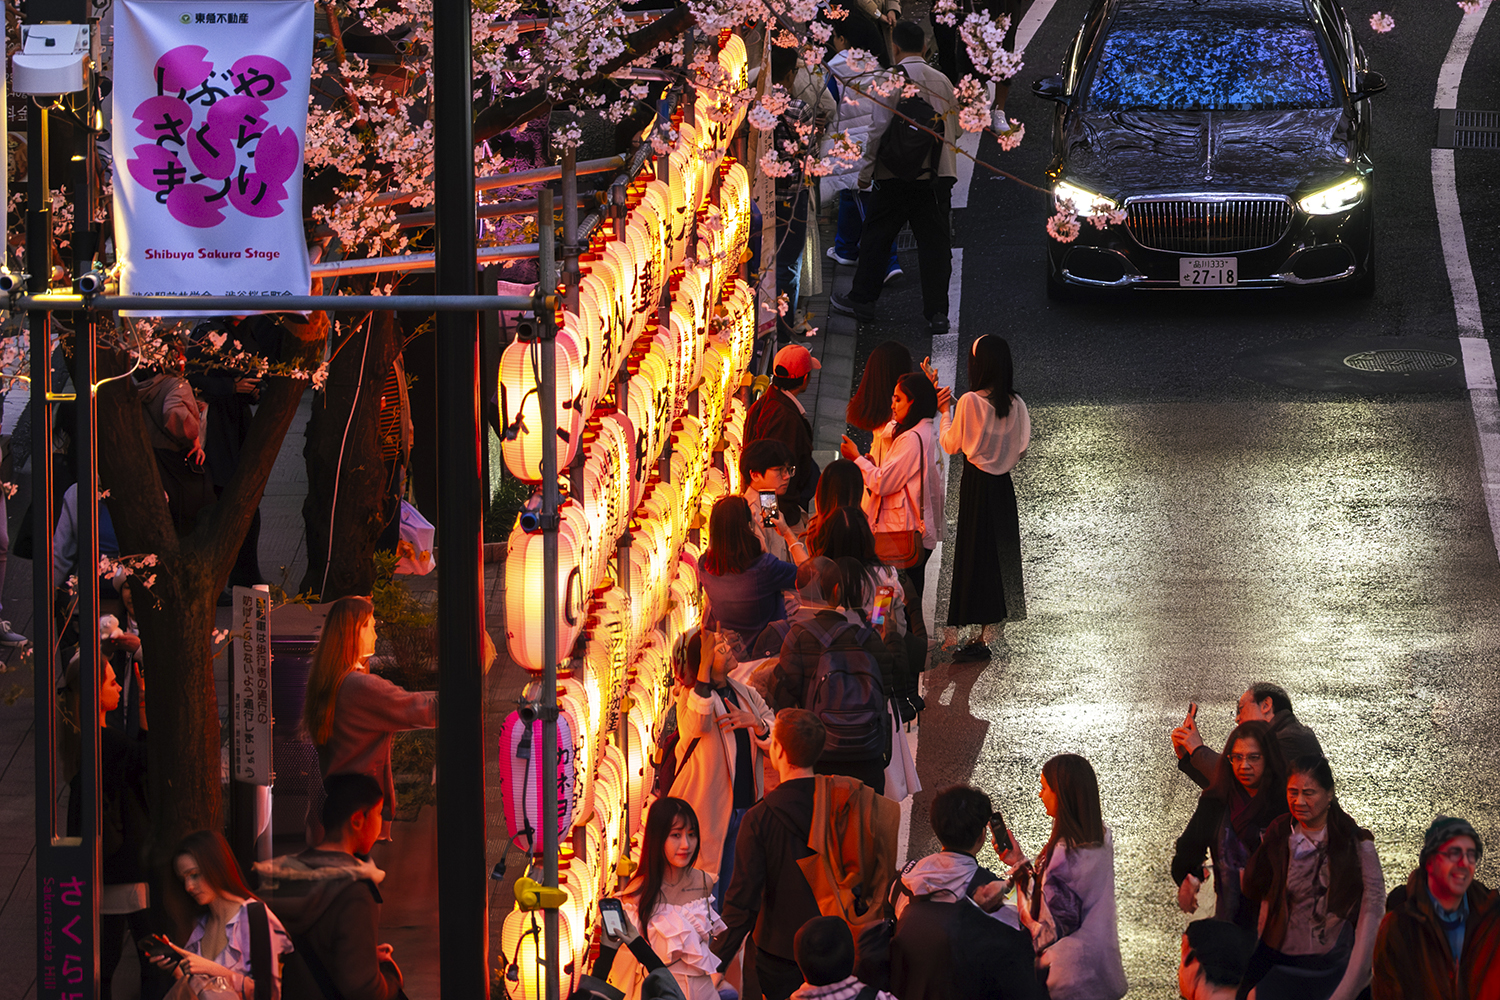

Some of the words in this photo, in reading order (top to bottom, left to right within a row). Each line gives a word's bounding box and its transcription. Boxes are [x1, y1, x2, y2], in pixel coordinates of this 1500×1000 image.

[195, 12, 249, 25] 東急不動産
[154, 113, 263, 158] さくら
[153, 161, 268, 206] まつり
[145, 248, 194, 261] Shibuya
[197, 247, 242, 259] Sakura
[244, 247, 280, 261] Stage
[1192, 269, 1234, 284] 27-18
[43, 877, 56, 961] Sakura-zaka
[44, 966, 56, 989] Hill
